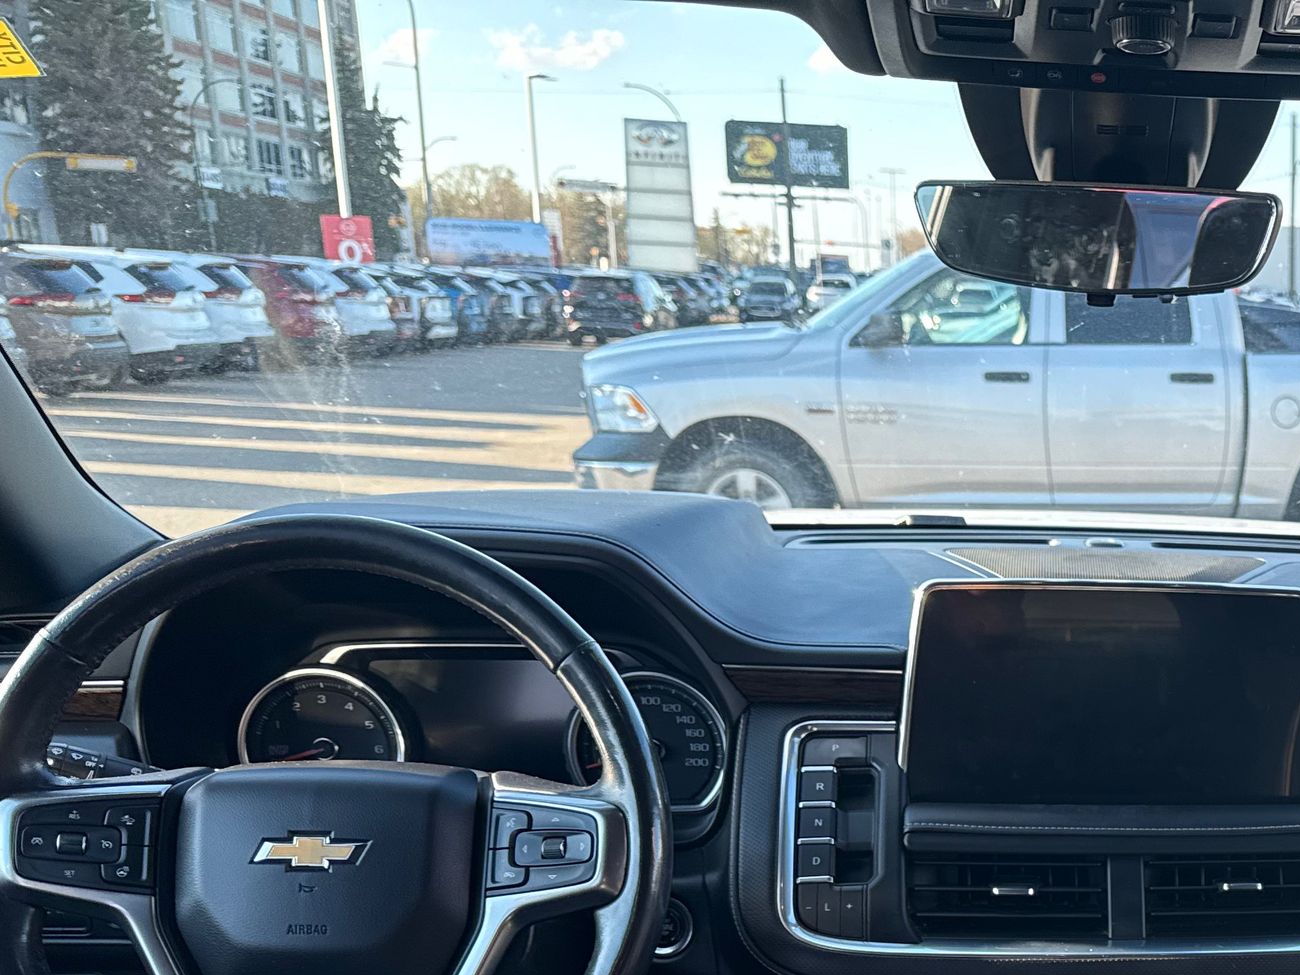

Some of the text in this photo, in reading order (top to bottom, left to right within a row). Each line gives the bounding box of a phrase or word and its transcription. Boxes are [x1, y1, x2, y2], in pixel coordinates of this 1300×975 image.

[317, 694, 327, 704] 3
[640, 696, 661, 706] 100
[291, 702, 301, 712] 2
[344, 702, 354, 711] 4
[662, 704, 681, 713] 120
[364, 720, 375, 730] 5
[675, 715, 696, 725] 140
[685, 728, 705, 738] 160
[689, 743, 710, 752] 180
[685, 758, 709, 767] 200
[816, 782, 825, 791] R
[814, 818, 823, 827] N
[812, 856, 821, 866] D
[287, 924, 328, 935] AIRBAG
